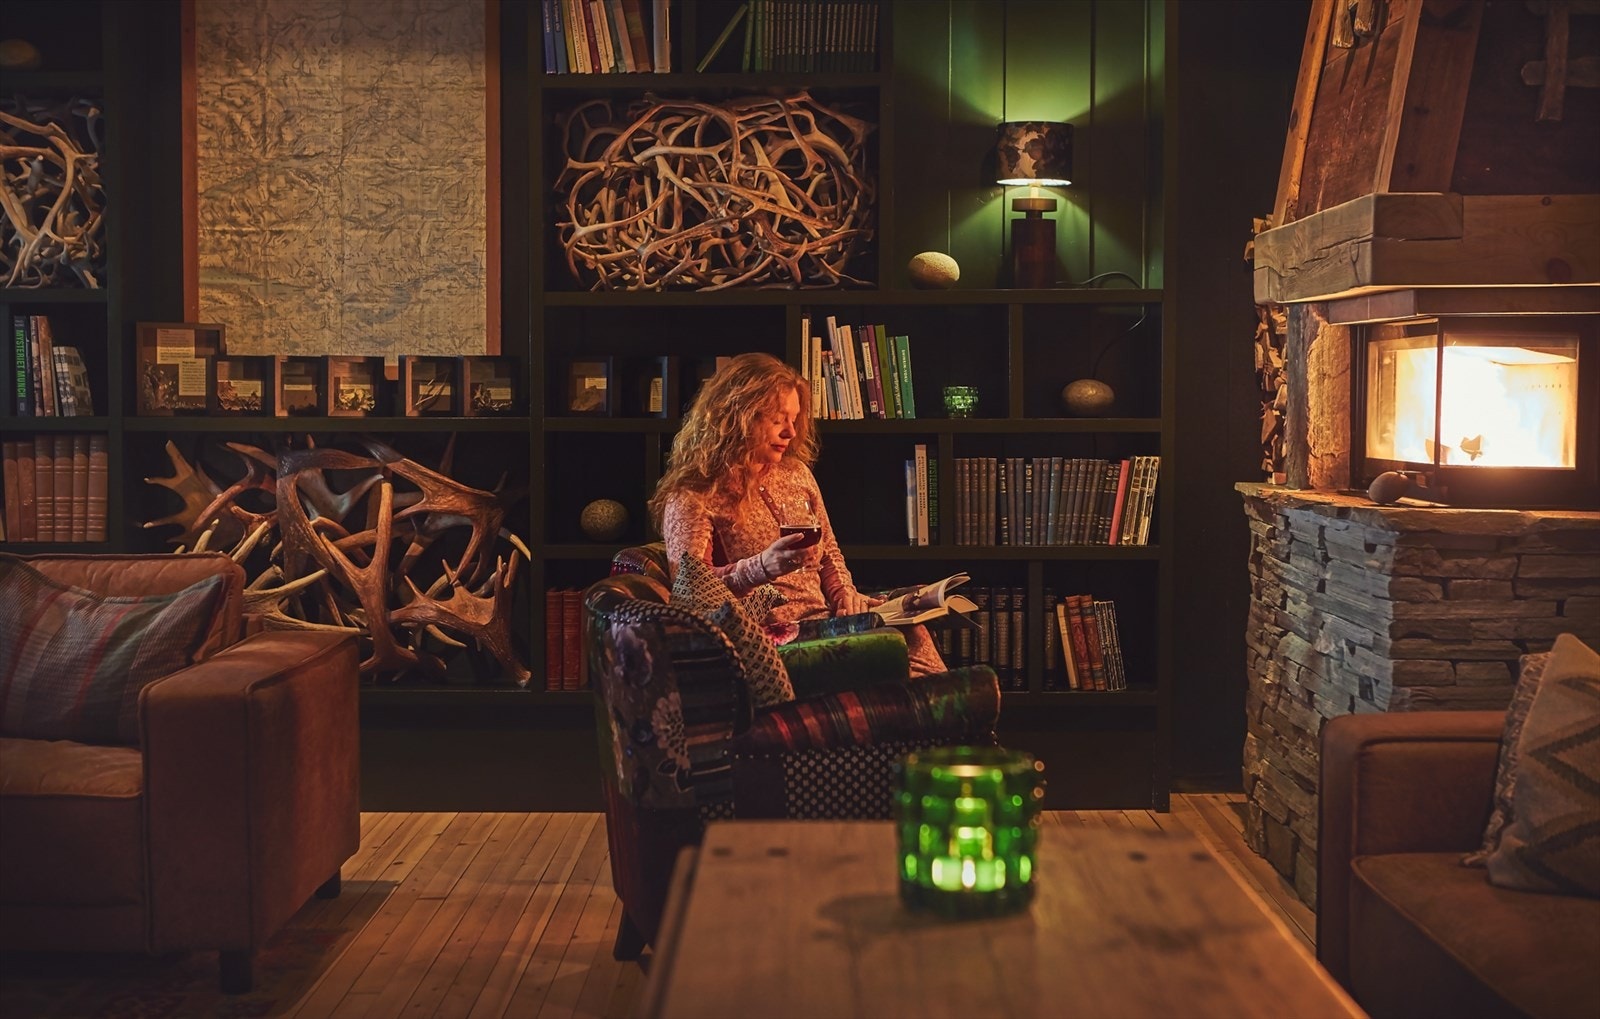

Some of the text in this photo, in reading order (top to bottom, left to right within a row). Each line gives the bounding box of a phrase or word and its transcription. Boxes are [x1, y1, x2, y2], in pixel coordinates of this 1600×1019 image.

[15, 329, 26, 369] MYSTERIET
[16, 370, 26, 398] MUNCH
[929, 459, 938, 527] MYSTERIET MUNCH
